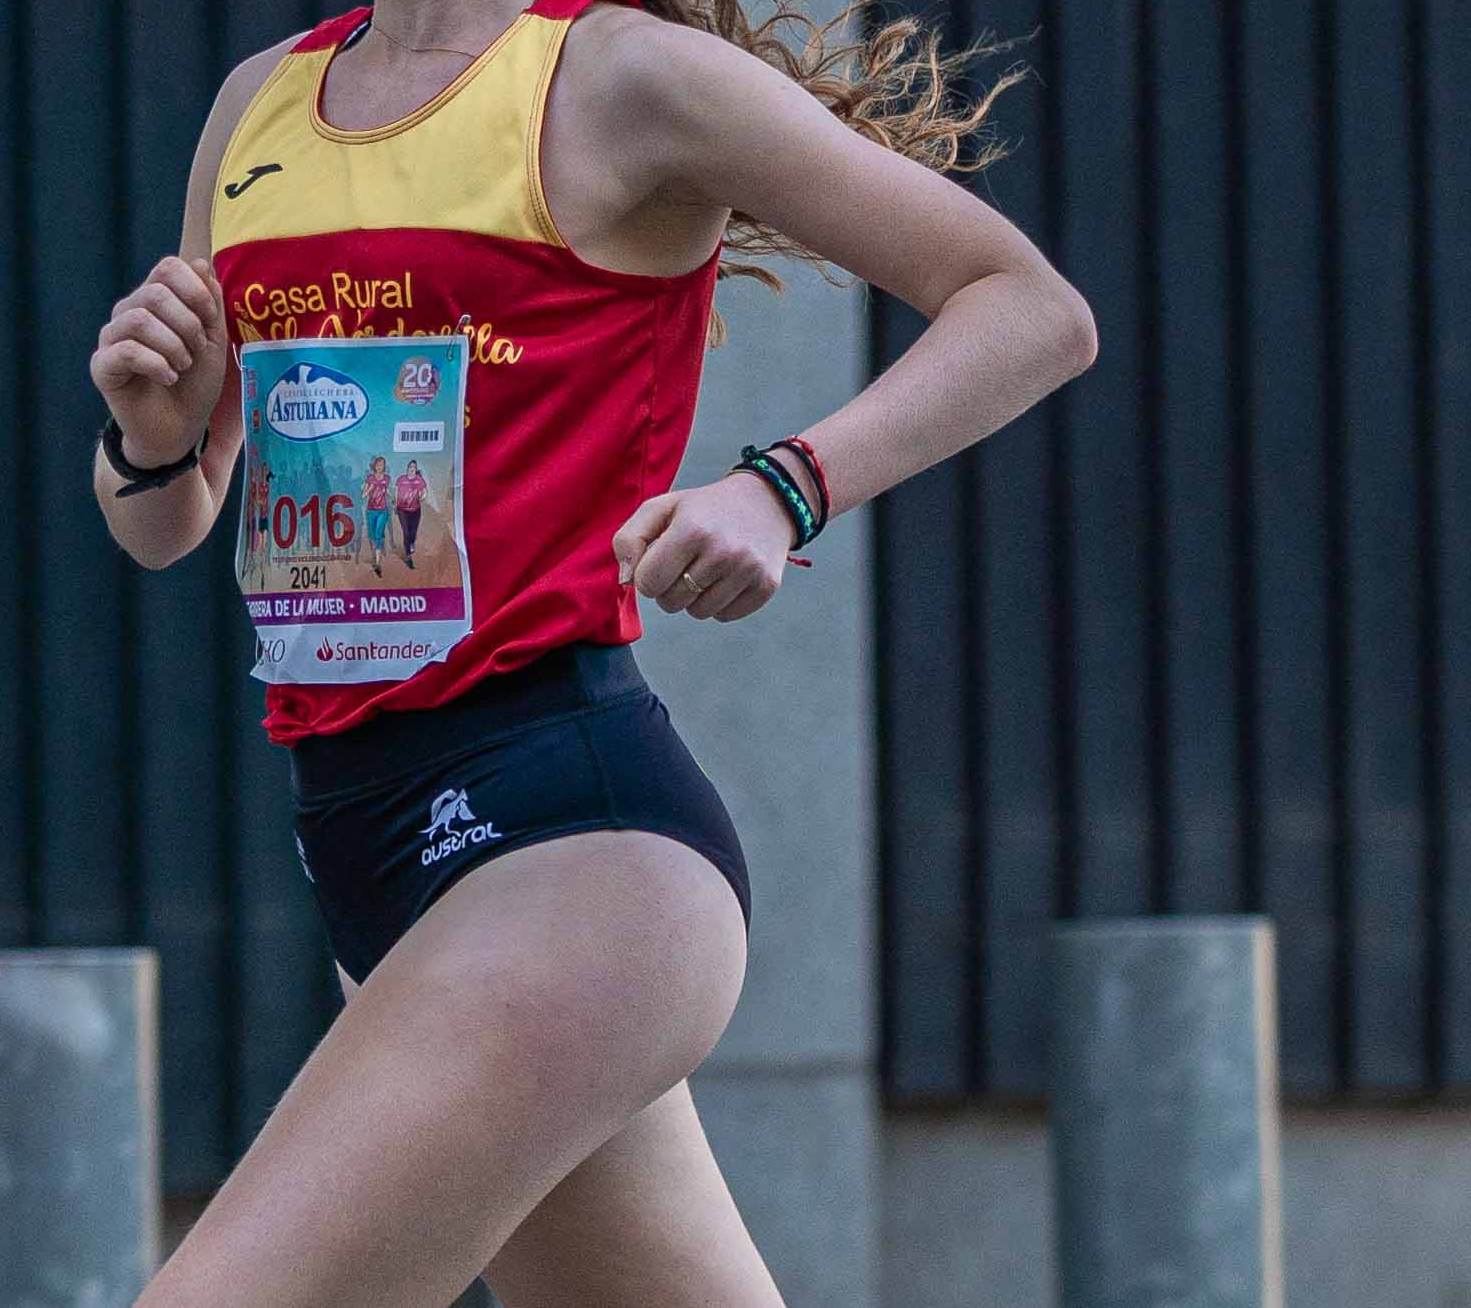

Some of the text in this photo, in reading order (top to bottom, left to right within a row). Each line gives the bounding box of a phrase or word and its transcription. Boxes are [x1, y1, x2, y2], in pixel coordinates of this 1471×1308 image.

[244, 282, 327, 321] Casa
[332, 271, 413, 310] Rural
[402, 363, 433, 388] 20
[270, 393, 358, 422] ASTURIANA
[272, 493, 355, 549] 016
[290, 565, 327, 589] 2041
[275, 599, 290, 617] DE
[293, 598, 305, 616] LA
[305, 597, 346, 616] MUJER
[360, 594, 427, 614] MADRID
[335, 639, 432, 661] Santander
